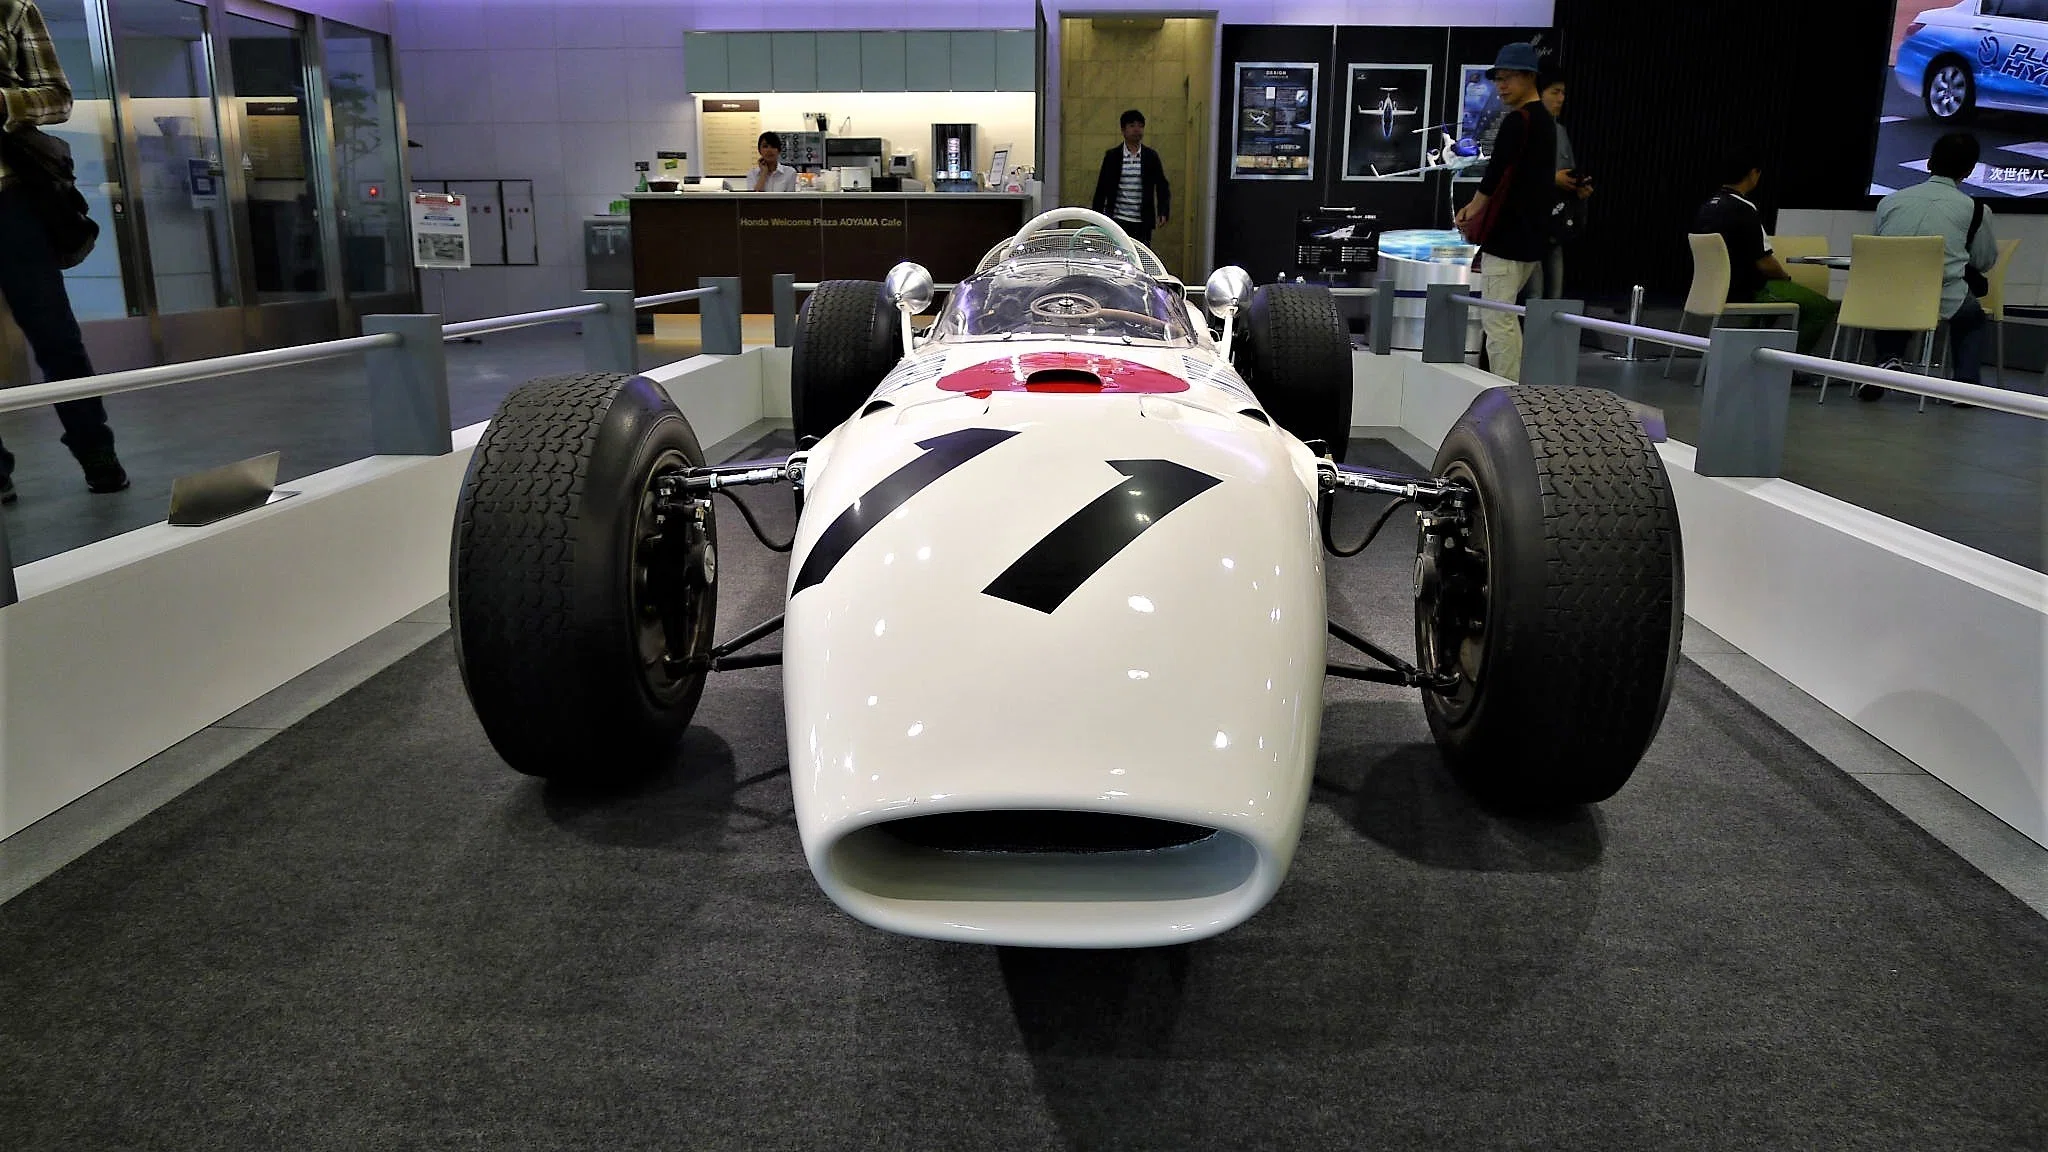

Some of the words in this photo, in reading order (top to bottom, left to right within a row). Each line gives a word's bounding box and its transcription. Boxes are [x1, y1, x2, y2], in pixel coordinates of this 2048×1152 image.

[740, 217, 769, 226] Honda
[770, 217, 811, 226] Welcome
[813, 217, 838, 226] Plaza
[839, 217, 880, 226] AOYAMA
[881, 217, 902, 226] Cafe
[789, 427, 1223, 615] 11
